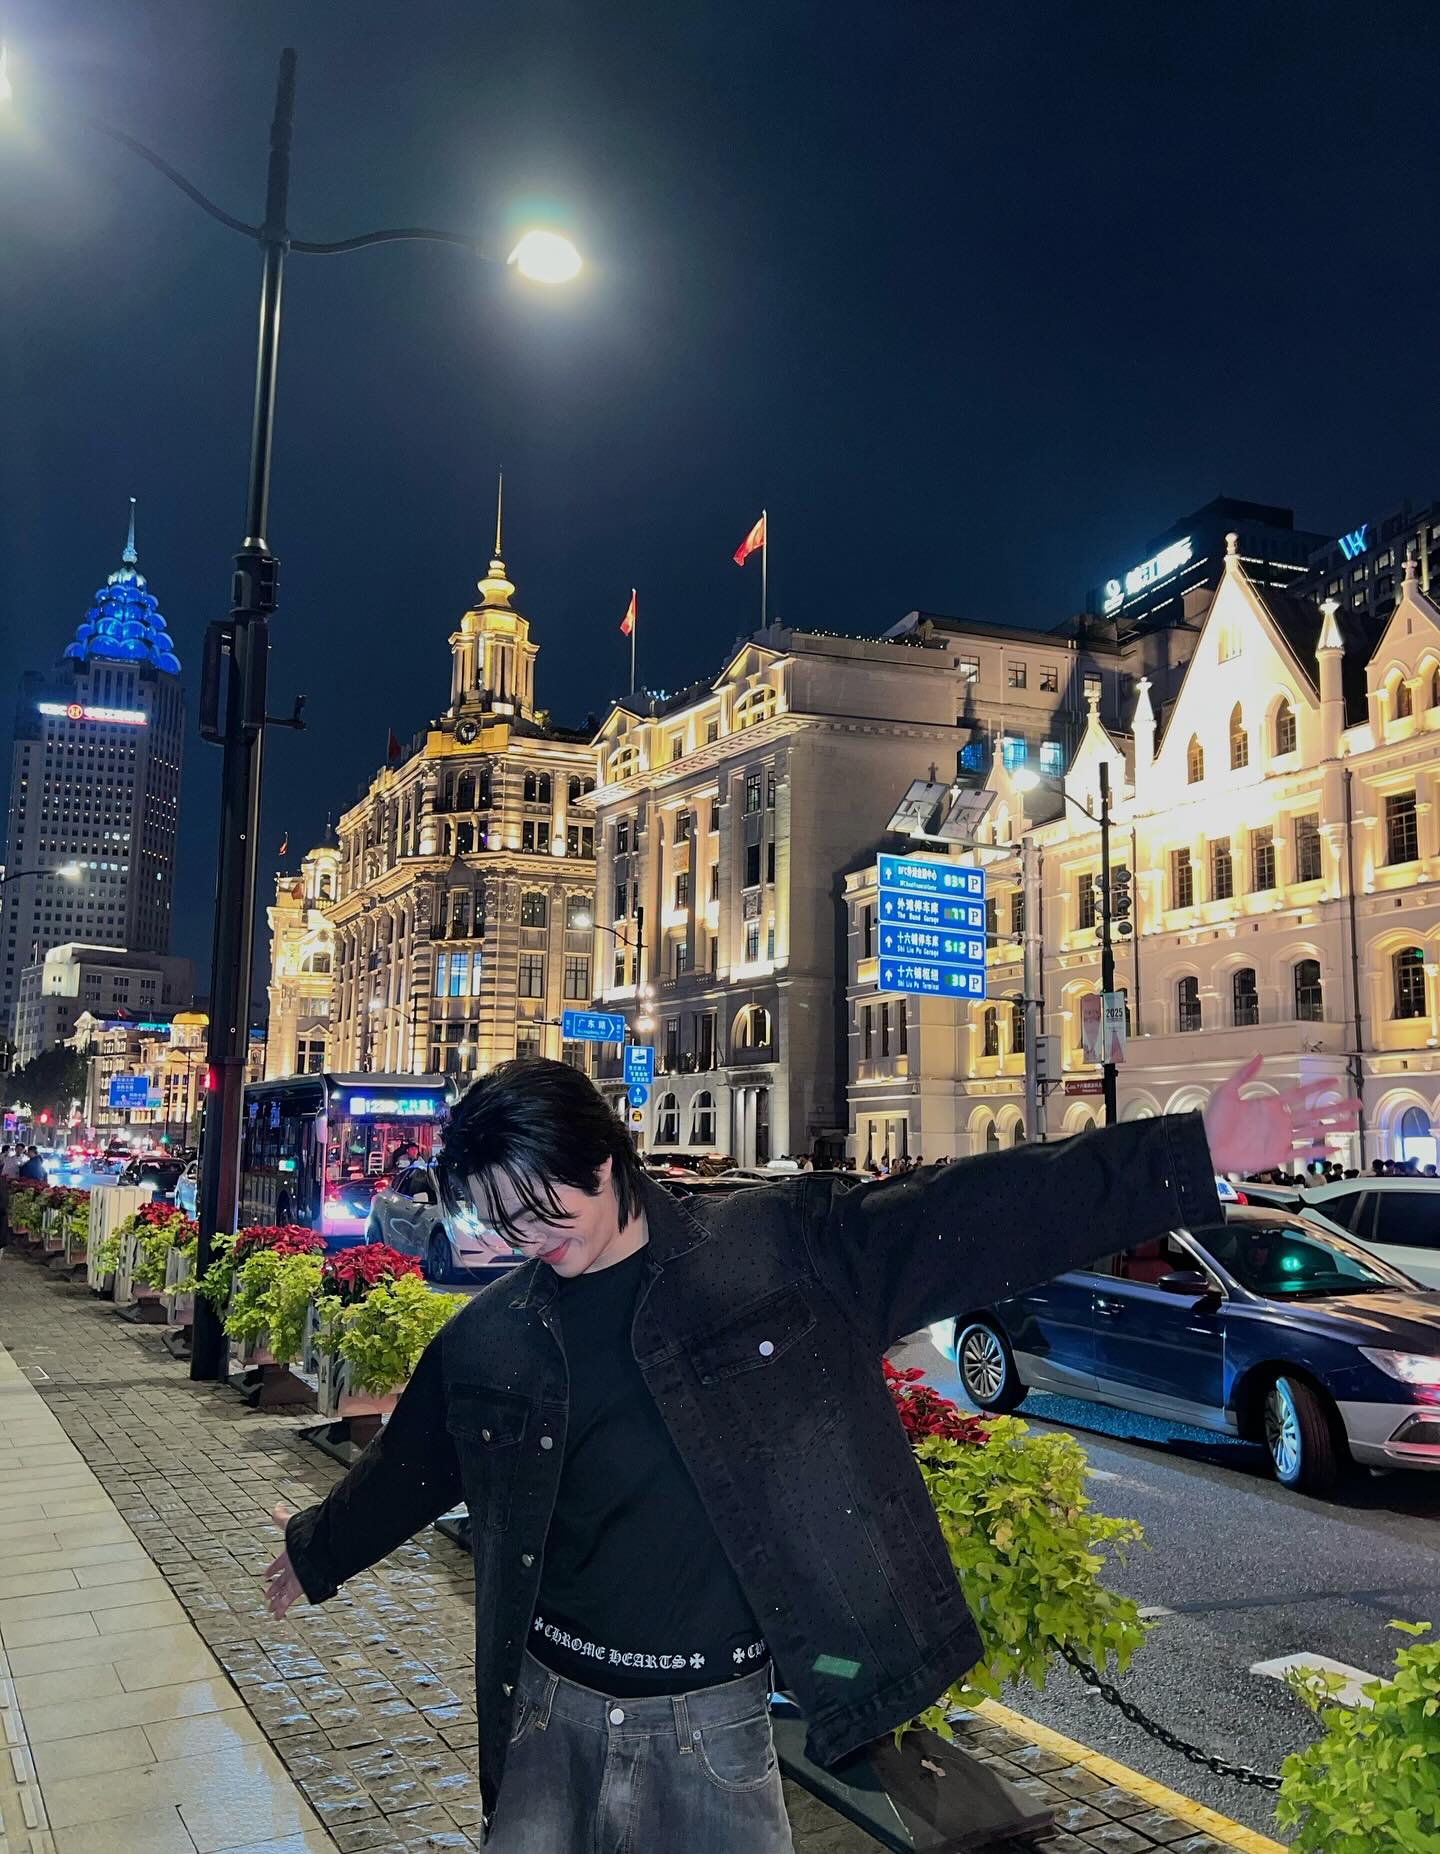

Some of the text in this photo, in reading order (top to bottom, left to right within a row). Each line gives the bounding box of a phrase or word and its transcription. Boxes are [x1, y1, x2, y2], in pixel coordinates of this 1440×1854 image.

[897, 897, 939, 914] 外滩停车库
[897, 911, 906, 919] The
[909, 912, 921, 921] Bund
[923, 914, 939, 925] Garage
[897, 931, 939, 947] 十六铺停车库
[1106, 1008, 1123, 1018] 2025
[577, 1019, 606, 1030] 广东路
[544, 1624, 687, 1670] CHROME HEARTS
